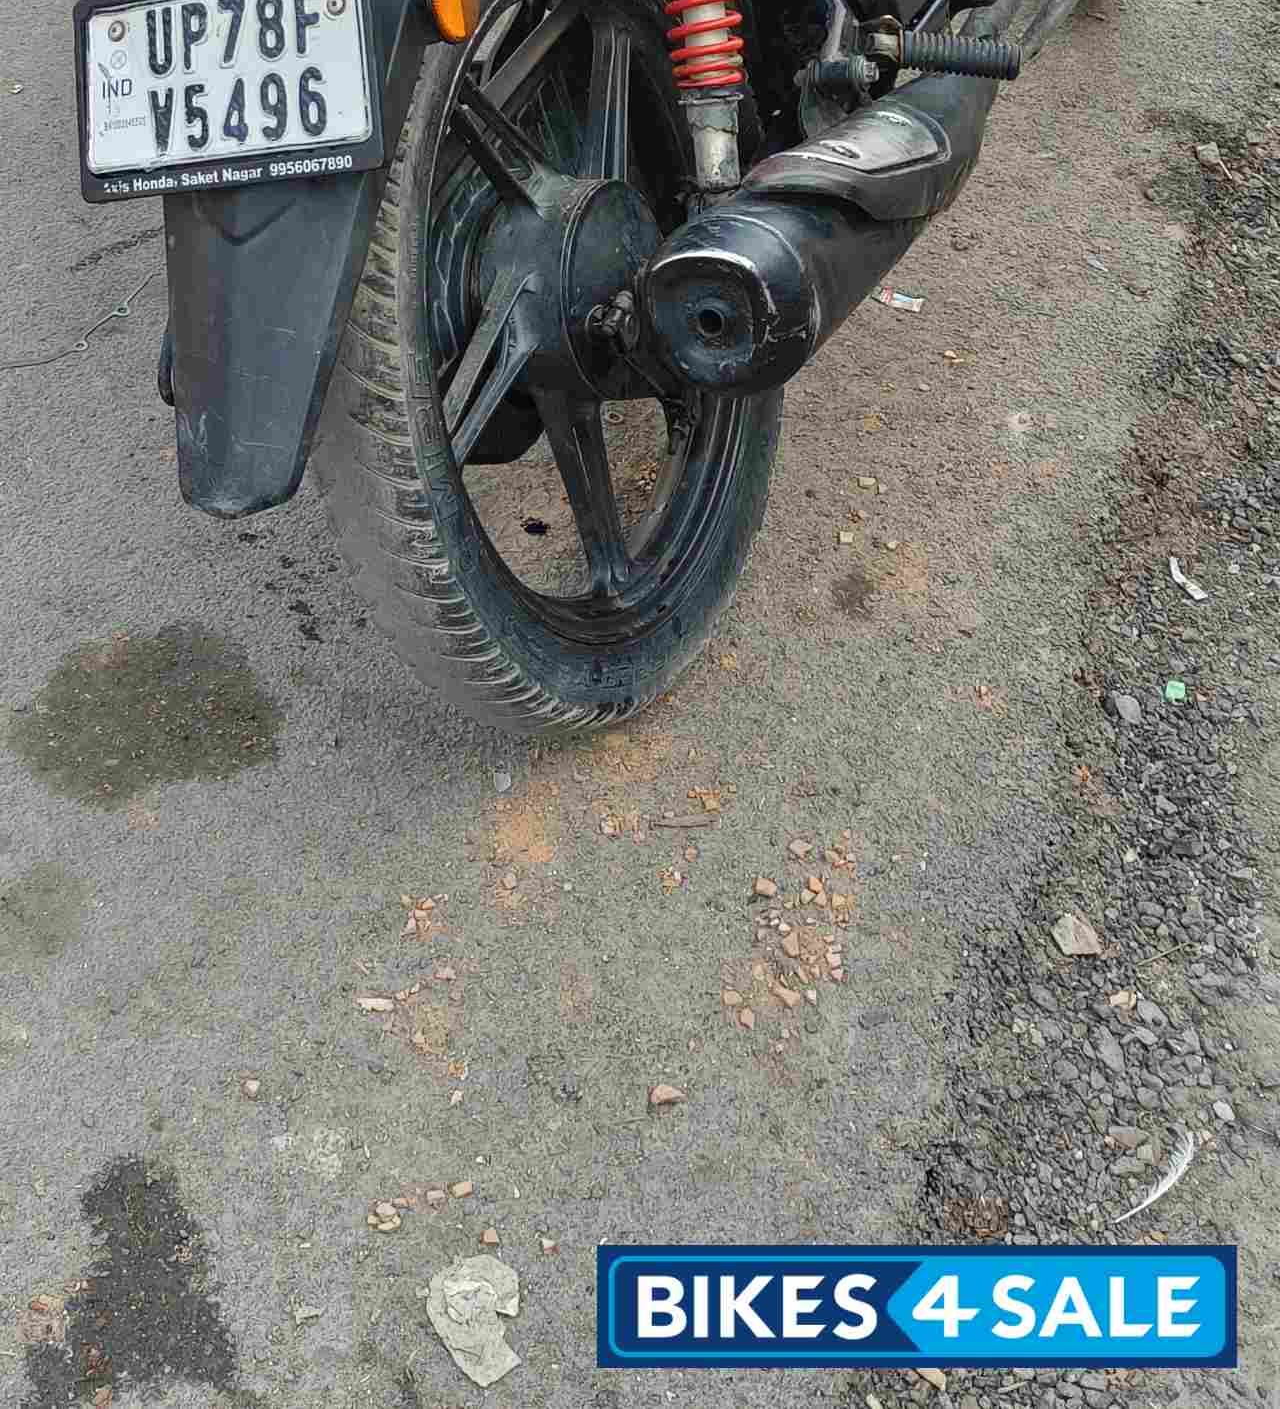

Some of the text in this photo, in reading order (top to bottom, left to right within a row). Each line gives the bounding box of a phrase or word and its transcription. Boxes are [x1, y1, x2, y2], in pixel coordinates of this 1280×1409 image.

[102, 78, 133, 99] IND
[149, 66, 327, 157] V5496
[132, 176, 178, 192] Honda,
[181, 169, 219, 187] Saket
[222, 165, 263, 185] Nagar
[269, 154, 353, 177] 9956067890
